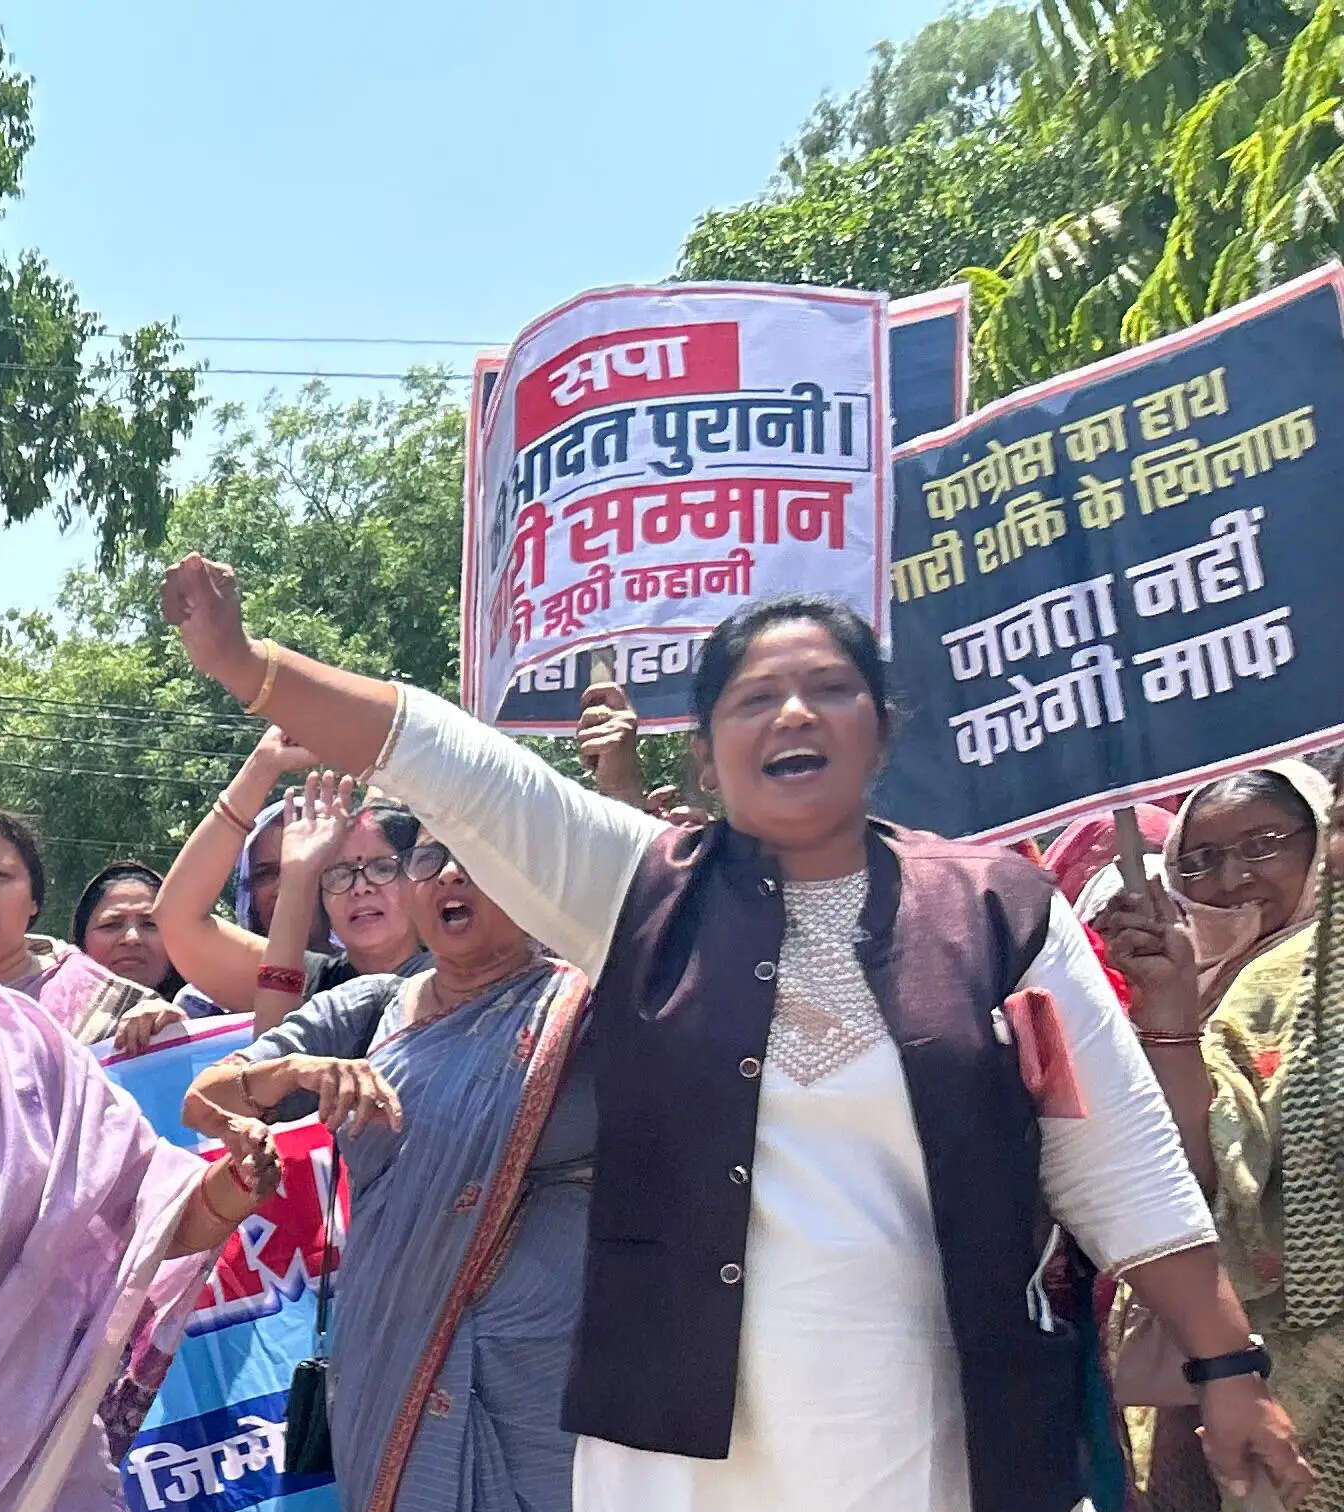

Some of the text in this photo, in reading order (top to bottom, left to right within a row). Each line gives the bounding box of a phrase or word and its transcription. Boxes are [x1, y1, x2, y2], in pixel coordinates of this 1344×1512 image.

[548, 335, 690, 407] सपा
[922, 367, 1230, 523] कांग्रेस का हाथ
[975, 488, 1069, 576] शक्ति
[1074, 472, 1128, 531] के
[1130, 404, 1318, 516] खिलाफ
[563, 480, 853, 565] सम्मान
[540, 563, 615, 637] झूठी
[621, 548, 756, 604] कहानी
[942, 506, 1267, 683] जनता नहीं
[948, 605, 1298, 768] करेगी माफ
[127, 1415, 289, 1512] जिम्मे
